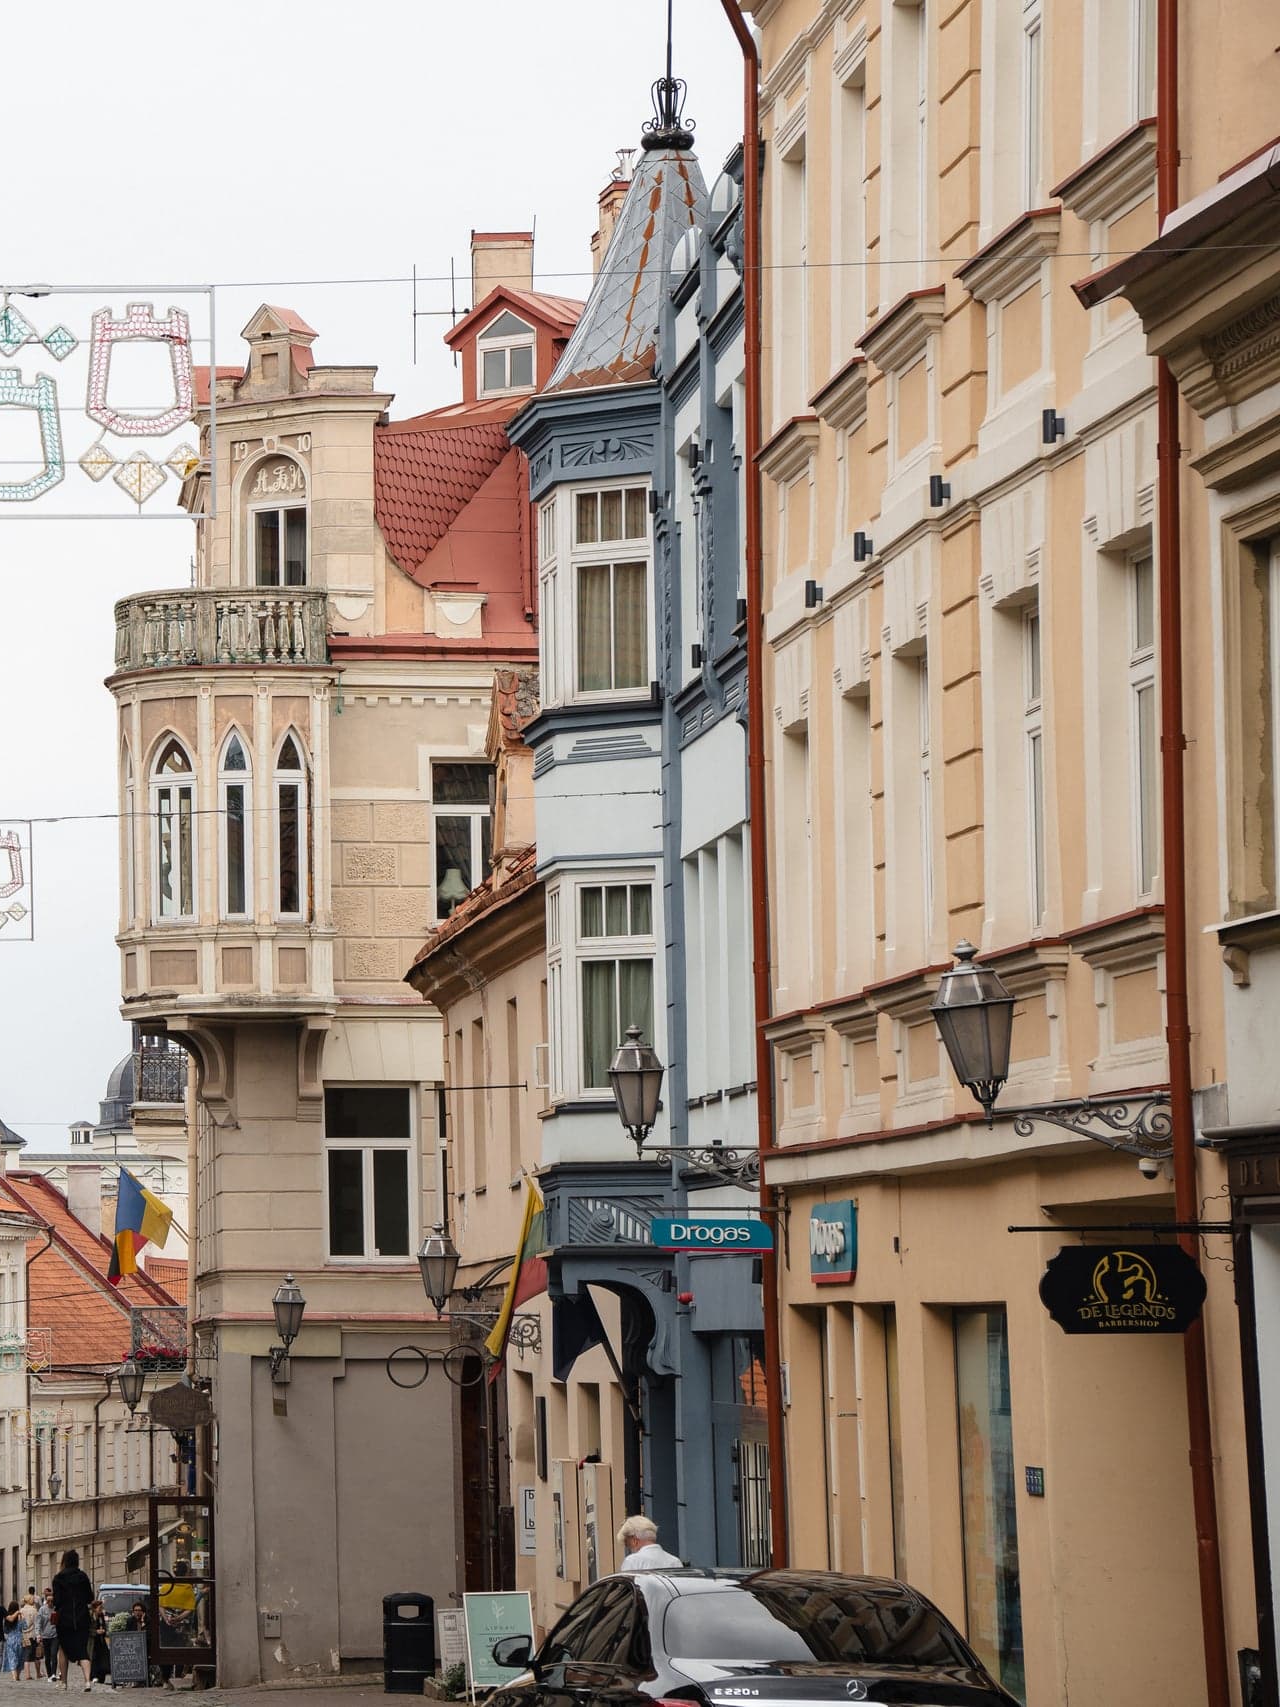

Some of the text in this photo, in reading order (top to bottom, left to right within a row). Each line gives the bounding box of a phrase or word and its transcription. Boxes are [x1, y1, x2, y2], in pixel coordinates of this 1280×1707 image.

[233, 434, 311, 461] 19 10
[1239, 1159, 1261, 1187] DE
[670, 1223, 751, 1245] Drogas
[1077, 1303, 1176, 1320] DE LEGENDS
[1098, 1320, 1160, 1328] BARBERSHOP
